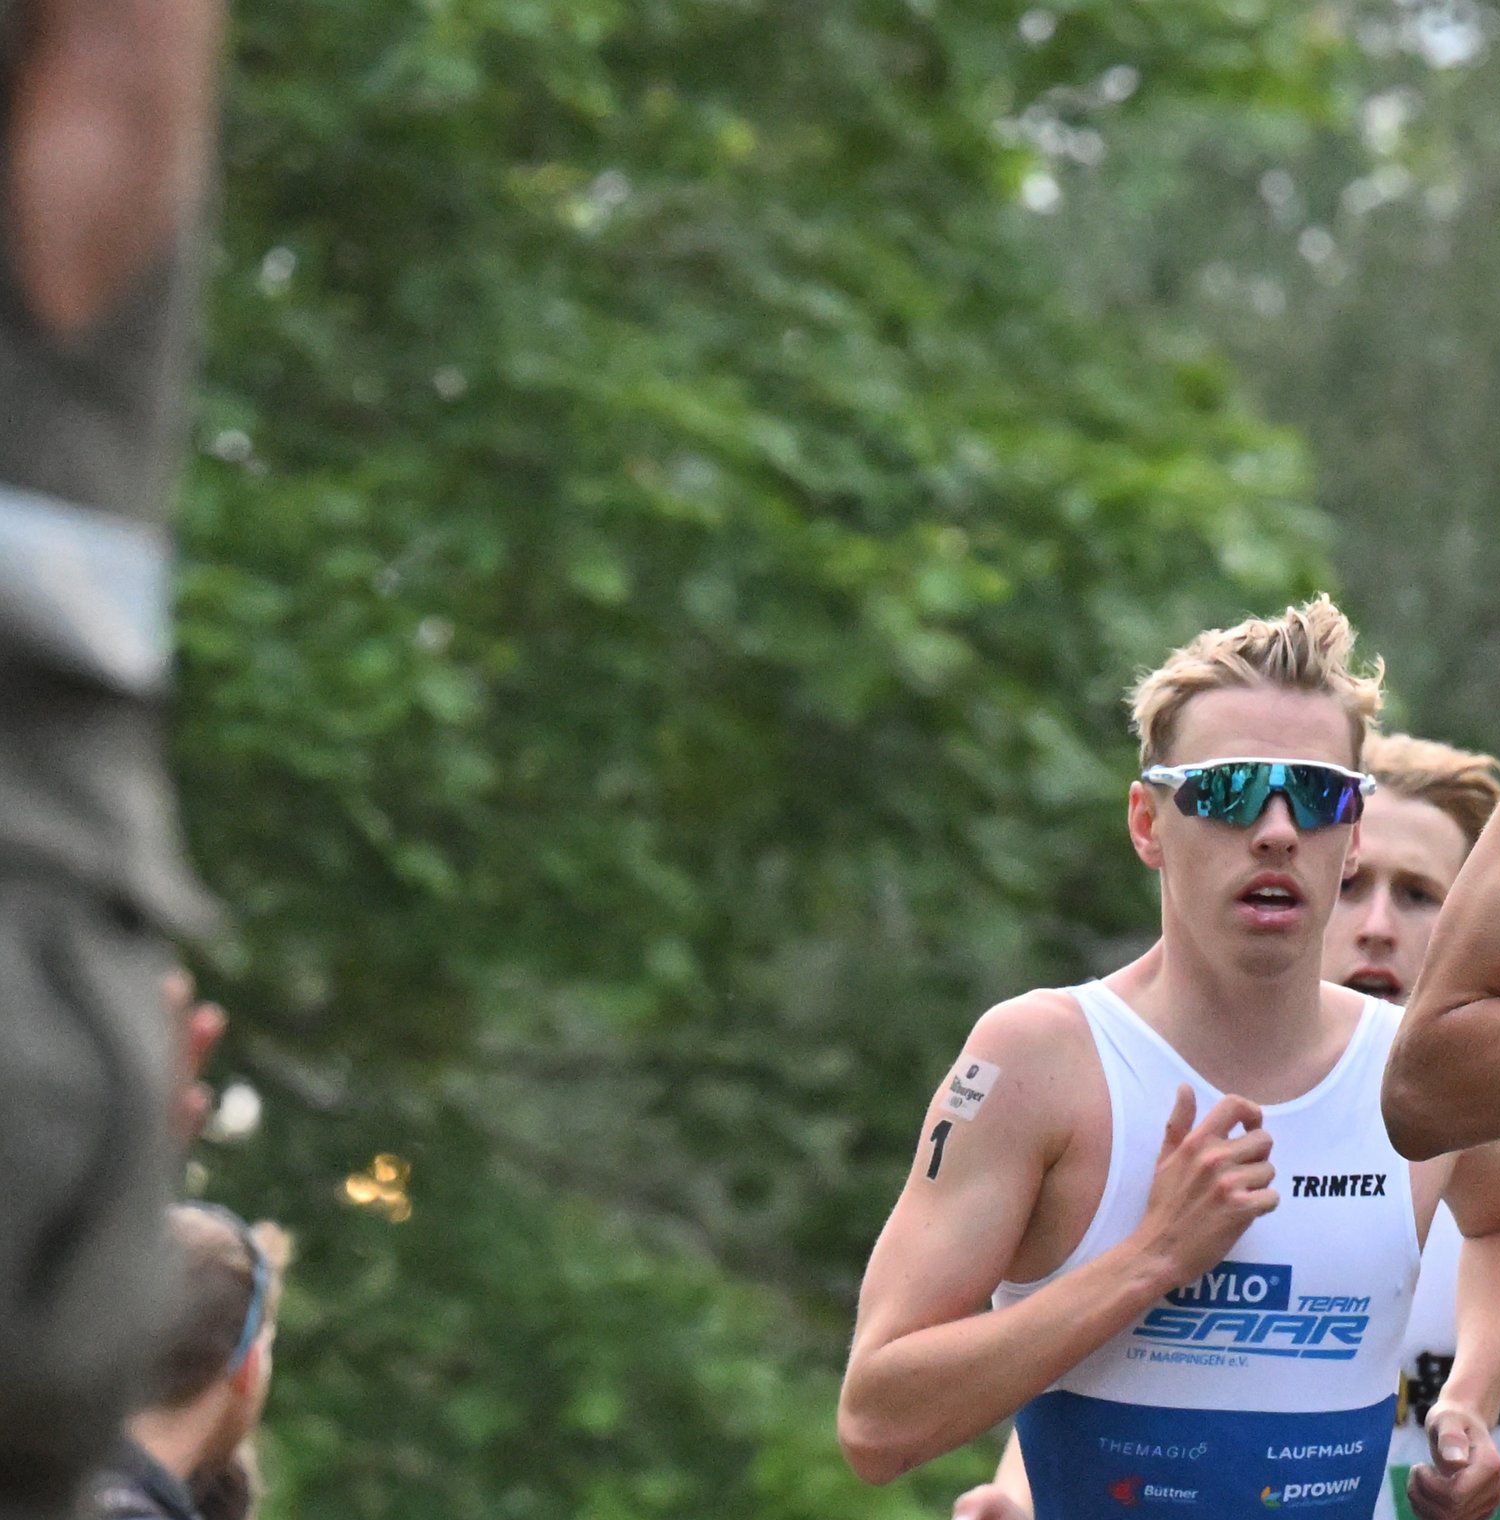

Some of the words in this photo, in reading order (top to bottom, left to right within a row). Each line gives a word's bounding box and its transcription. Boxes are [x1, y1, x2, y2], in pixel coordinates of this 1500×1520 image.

[926, 1119, 953, 1181] 1
[1292, 1174, 1387, 1197] TRIMTEX
[1133, 1308, 1370, 1345] SAAR
[1267, 1440, 1364, 1460] LAUFMAUS
[1143, 1484, 1198, 1500] Büttner
